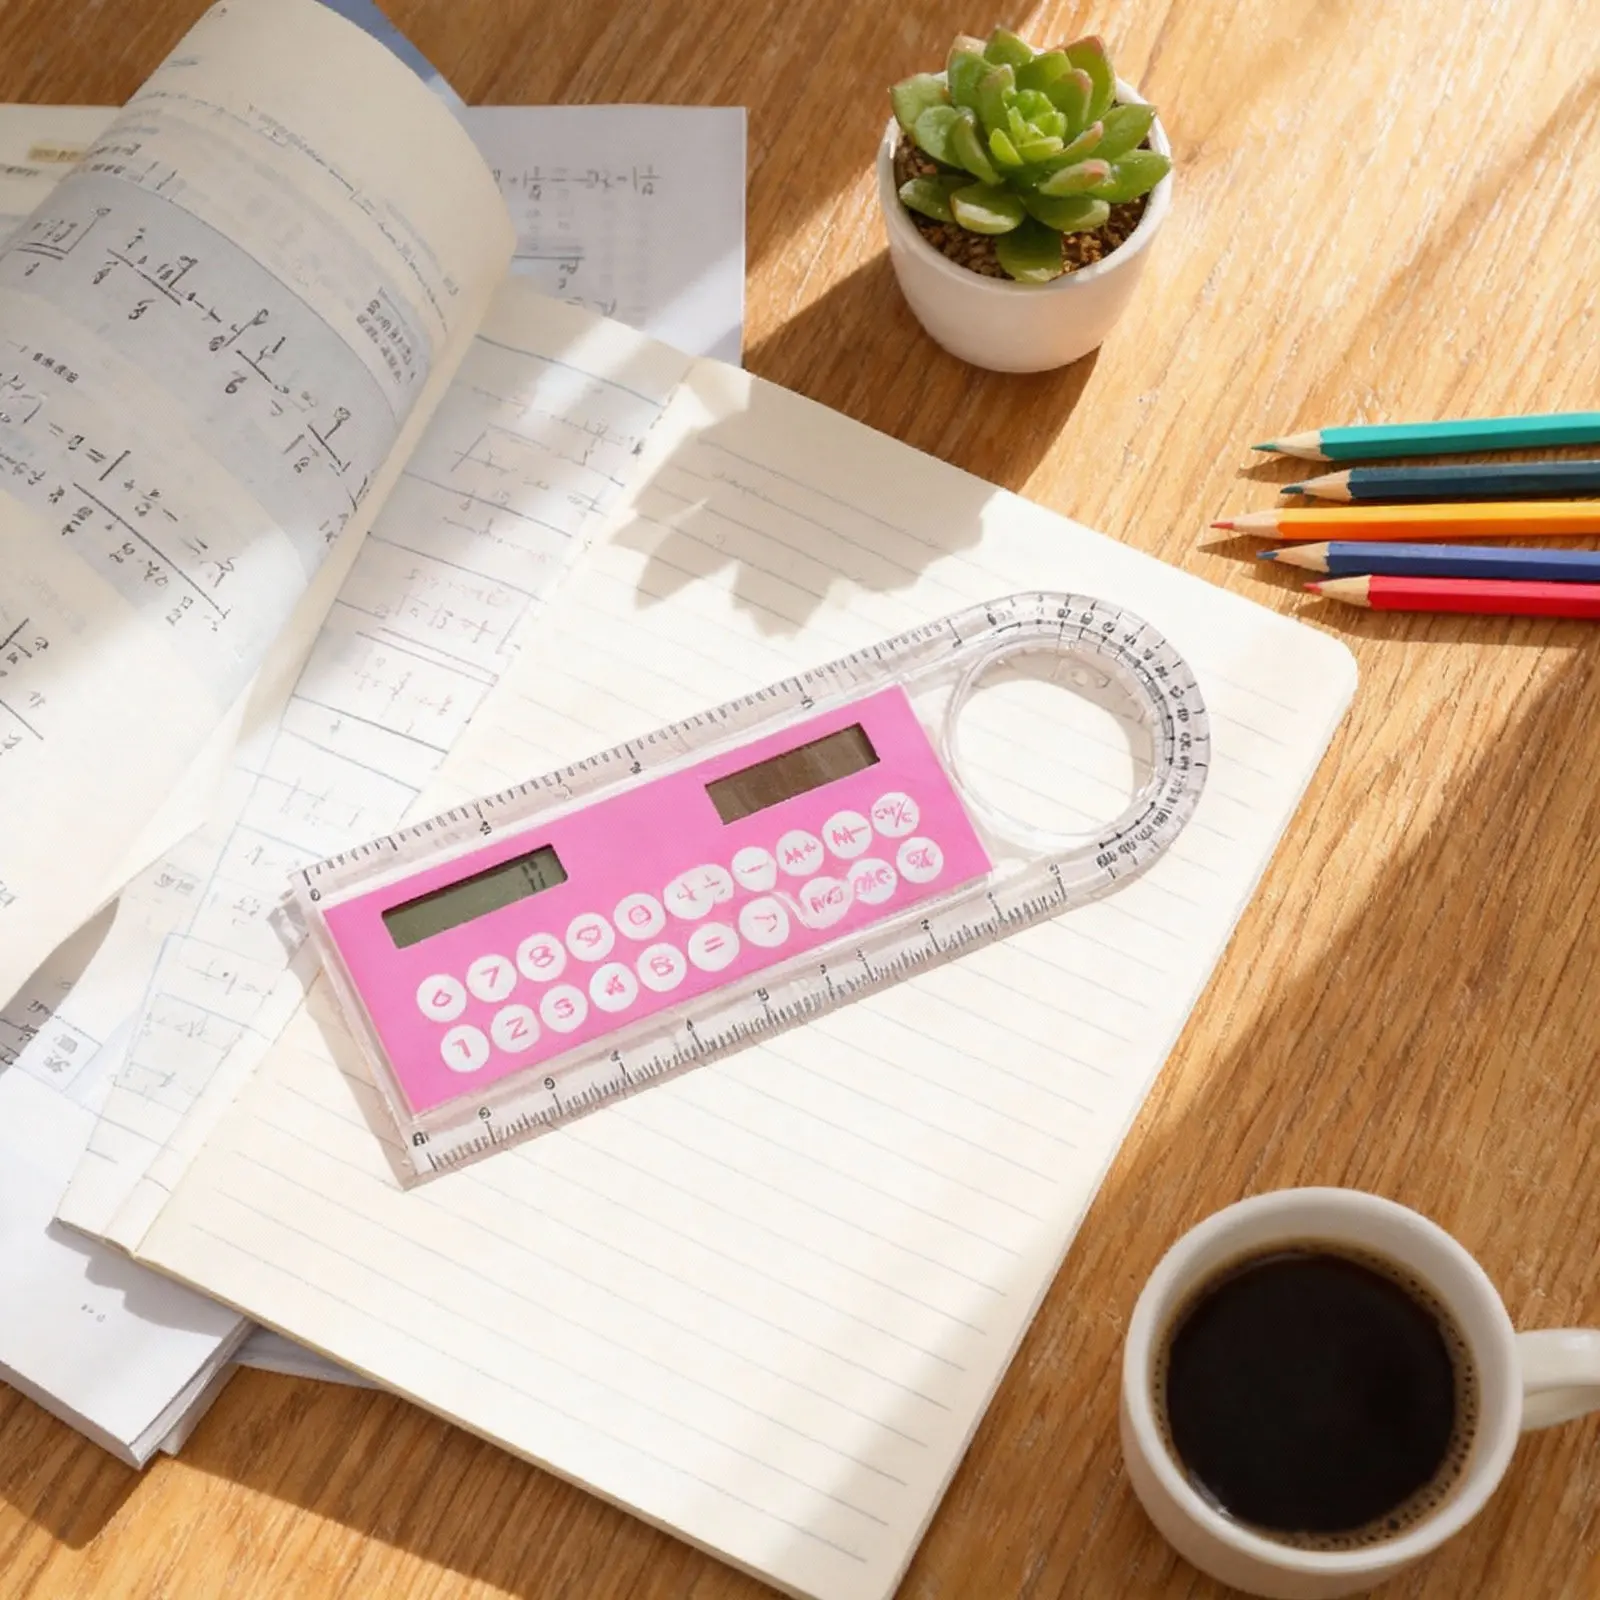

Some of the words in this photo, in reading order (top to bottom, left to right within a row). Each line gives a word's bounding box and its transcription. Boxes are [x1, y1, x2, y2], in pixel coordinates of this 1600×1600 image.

[480, 965, 500, 989] 7
[528, 944, 556, 969] 8
[627, 904, 652, 927] 0
[452, 1037, 473, 1059] 1
[505, 1015, 529, 1041] 2
